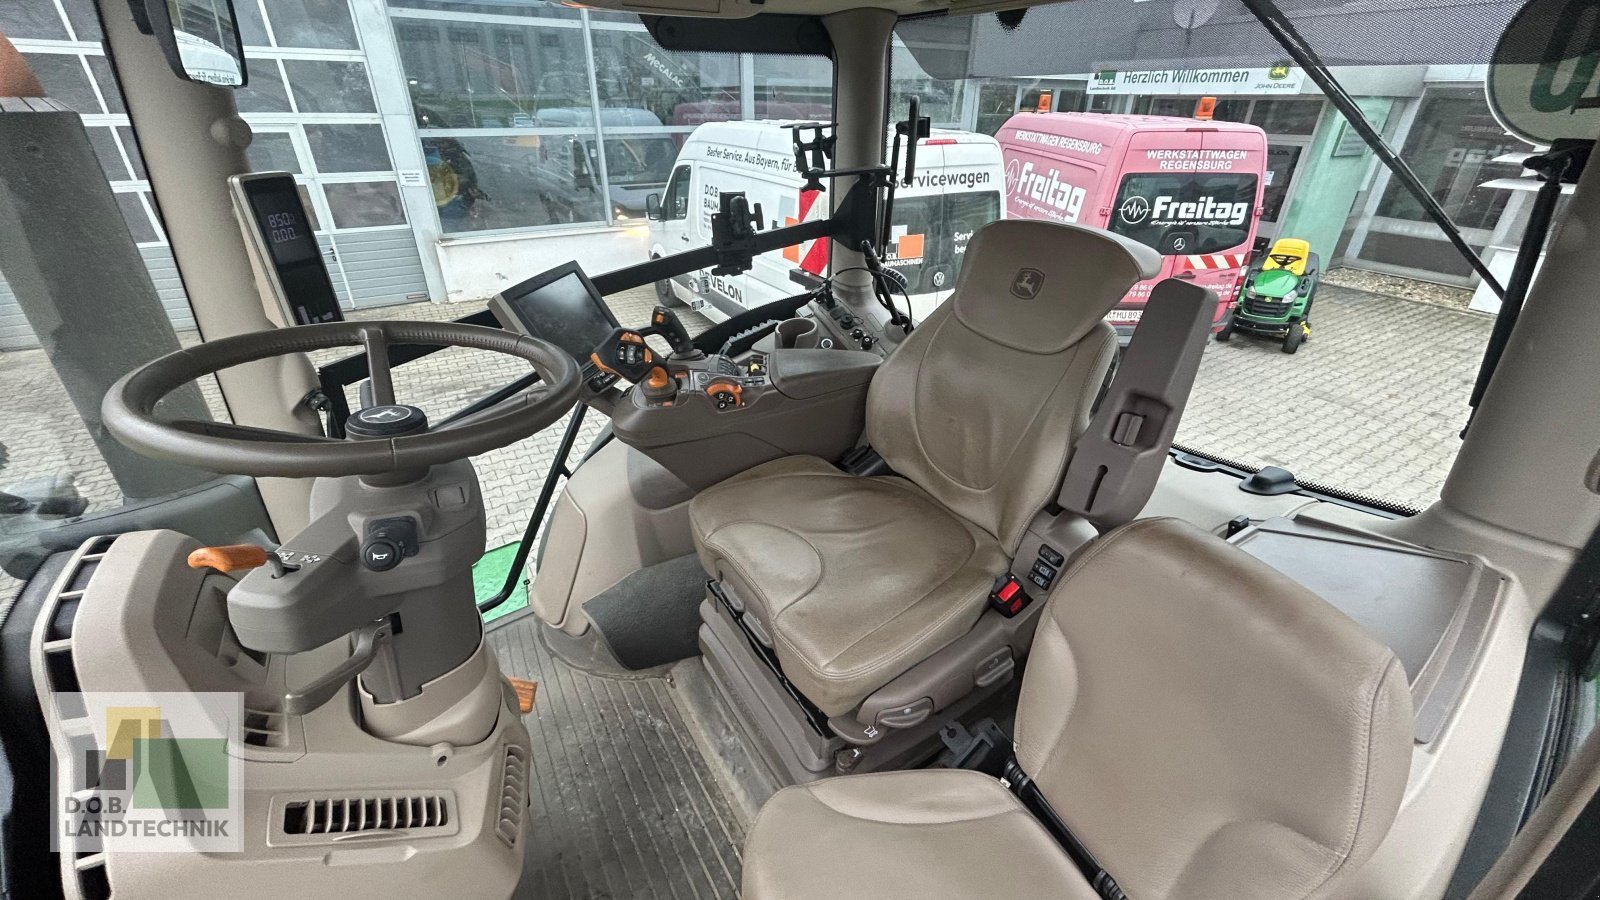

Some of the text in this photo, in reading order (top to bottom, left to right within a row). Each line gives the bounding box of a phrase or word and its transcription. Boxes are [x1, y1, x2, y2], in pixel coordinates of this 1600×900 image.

[1123, 69, 1250, 84] Herzlich Willkommen
[1015, 130, 1103, 155] WERKSTATTWAGEN REGENSBURG
[1147, 150, 1247, 160] WERKSTATTWAGEN
[706, 146, 722, 159] Bester
[722, 148, 744, 162] Service.
[743, 151, 756, 165] Aus
[755, 153, 780, 172] Bayern,
[780, 158, 793, 172] für
[1160, 160, 1233, 170] REGENSBURG
[703, 197, 721, 212] BAUM
[1017, 161, 1087, 224] Freitag
[1151, 195, 1249, 226] Freitag
[700, 269, 743, 304] VELON
